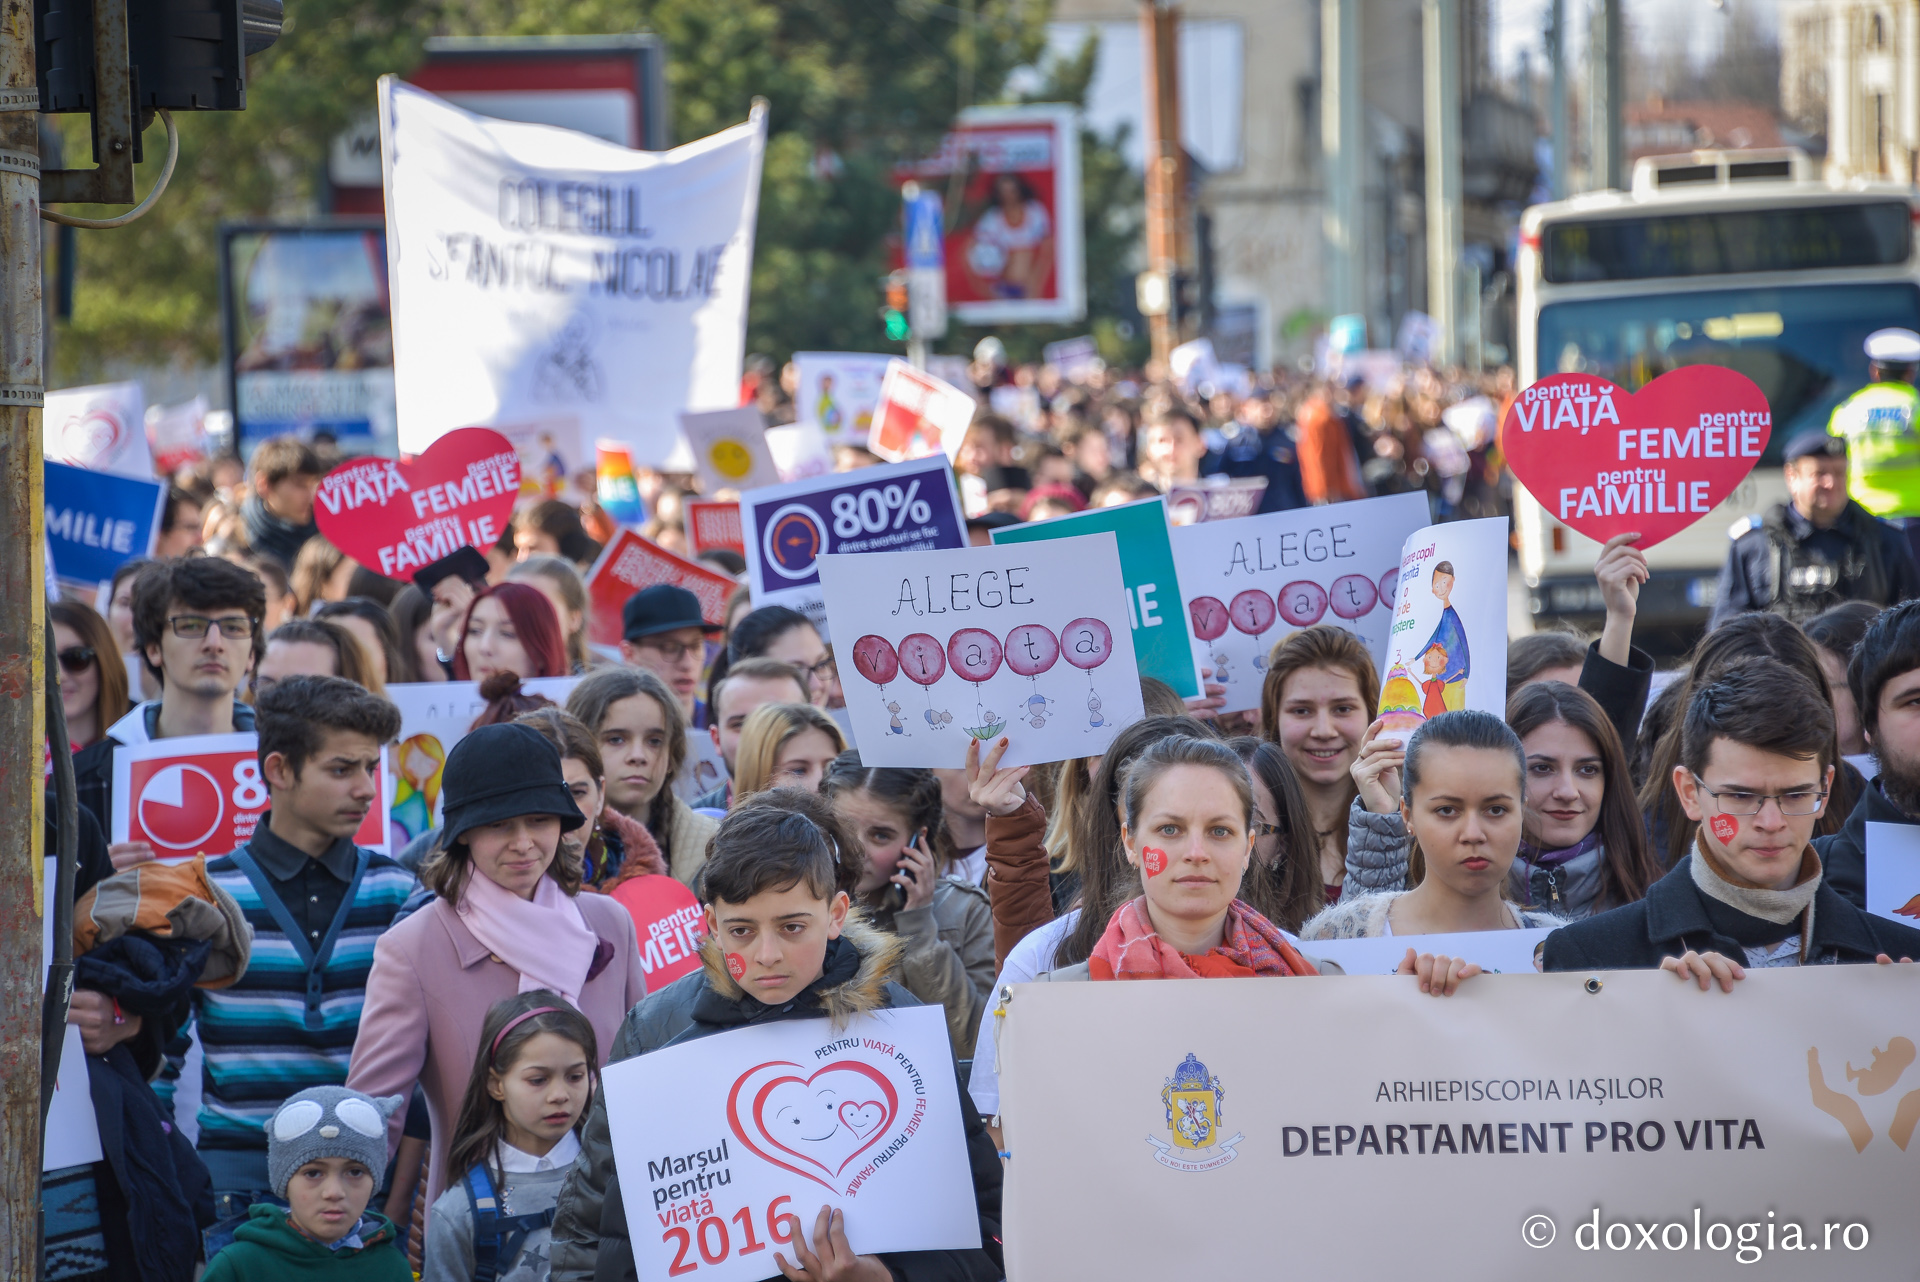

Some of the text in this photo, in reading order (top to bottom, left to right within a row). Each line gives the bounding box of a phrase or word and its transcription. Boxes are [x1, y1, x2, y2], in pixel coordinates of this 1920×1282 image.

[1515, 385, 1620, 435] VIAȚĂ
[1524, 382, 1591, 405] pentru
[1700, 410, 1771, 431] pentru
[1619, 426, 1761, 461] FEMEIE
[322, 462, 378, 493] pentru
[467, 451, 519, 479] pentru
[1598, 467, 1666, 490] pentru
[318, 461, 410, 515] VIAȚĂ
[410, 464, 520, 519] FEMEIE
[1560, 481, 1711, 520] FAMILIE
[830, 478, 932, 539] 80%
[378, 515, 499, 576] FAMILIE
[404, 515, 460, 544] pentru
[1224, 523, 1356, 577] ALEGE
[1416, 543, 1436, 562] copil
[891, 566, 1034, 616] ALEGE
[1401, 600, 1411, 614] de
[1403, 587, 1408, 598] o
[1714, 819, 1727, 830] pro
[1146, 852, 1159, 862] pro
[648, 902, 703, 941] pentru
[1375, 1077, 1665, 1106] ARHIEPISCOPIA IAȘILOR
[814, 1037, 927, 1198] PENTRU VIAȚĂ PENTRU FEMEIE PENTRU FAMILIE
[1281, 1118, 1766, 1158] DEPARTAMENT PRO VITA
[647, 1138, 729, 1182] Marșul
[1160, 1156, 1169, 1164] CU
[1199, 1154, 1232, 1170] DUMNEZEU
[652, 1168, 732, 1211] pentru
[657, 1192, 715, 1228] viață
[662, 1195, 795, 1278] 2016
